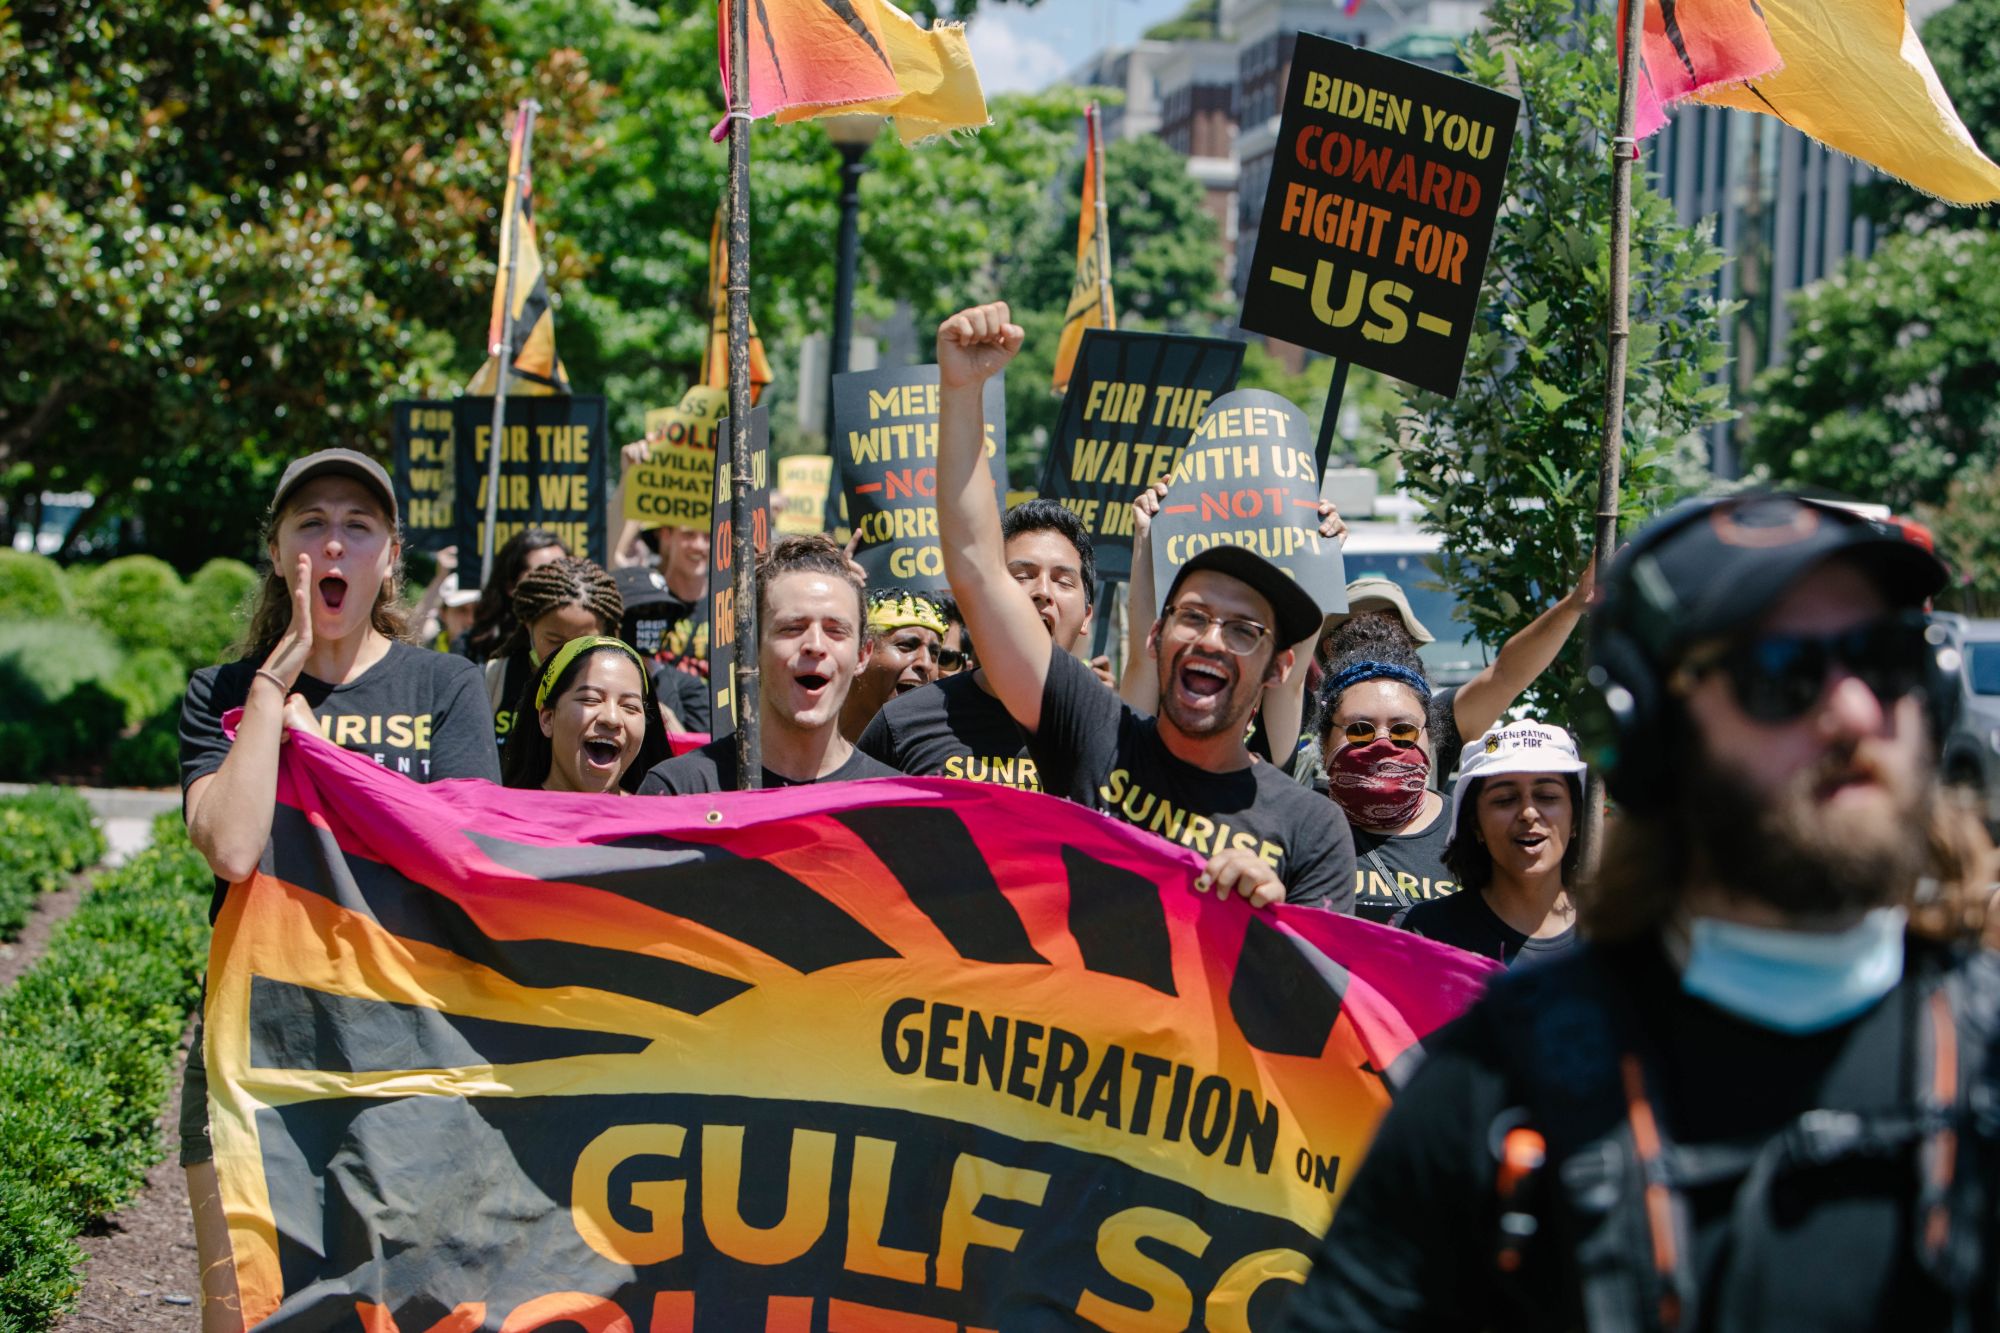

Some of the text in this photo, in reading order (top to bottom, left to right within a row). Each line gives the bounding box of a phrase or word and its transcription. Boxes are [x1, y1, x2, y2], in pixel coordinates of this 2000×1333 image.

[1303, 71, 1495, 160] BIDEN YOU
[1296, 125, 1482, 217] COWARD
[1280, 182, 1469, 285] FIGHT FOR
[868, 384, 940, 420] MEE
[1084, 380, 1213, 429] FOR THE
[536, 425, 589, 463] THE
[1189, 407, 1290, 447] MEET
[1271, 445, 1317, 483] US
[538, 474, 588, 510] WE
[637, 493, 713, 519] CORP
[860, 507, 940, 545] CORR
[1497, 729, 1552, 741] GENERATION
[1523, 739, 1542, 748] FIRE
[881, 997, 1340, 1193] GENERATION ON
[571, 1123, 1051, 1291] GULF
